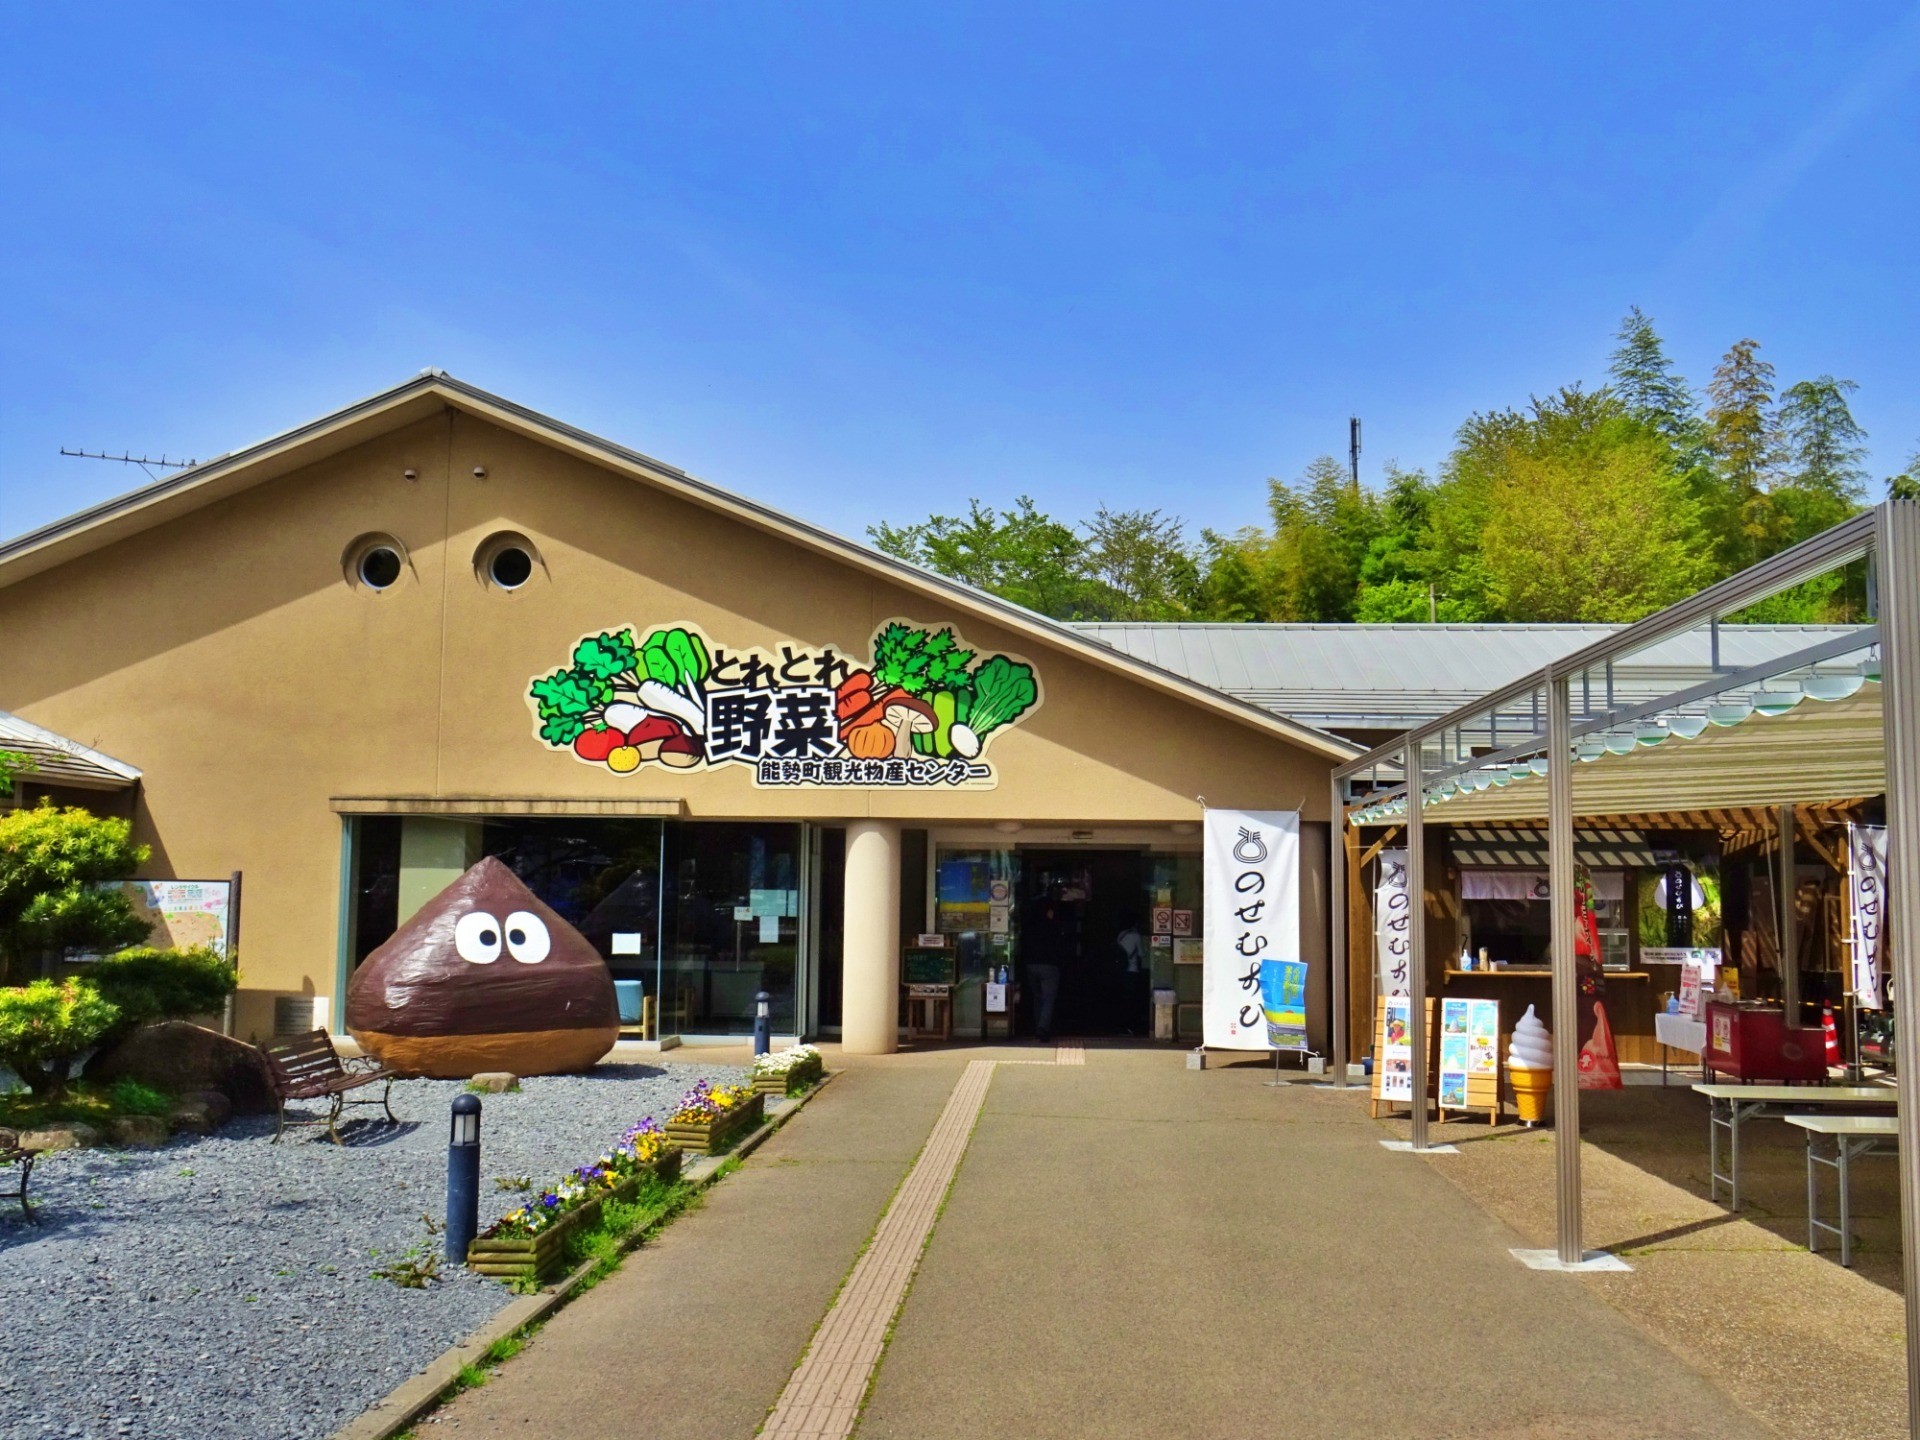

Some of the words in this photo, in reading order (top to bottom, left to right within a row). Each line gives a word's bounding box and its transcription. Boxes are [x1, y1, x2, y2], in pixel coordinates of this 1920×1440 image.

[711, 646, 848, 692] とれとれ
[711, 692, 839, 758] 野菜
[761, 761, 988, 783] 能勢町観光物産センター
